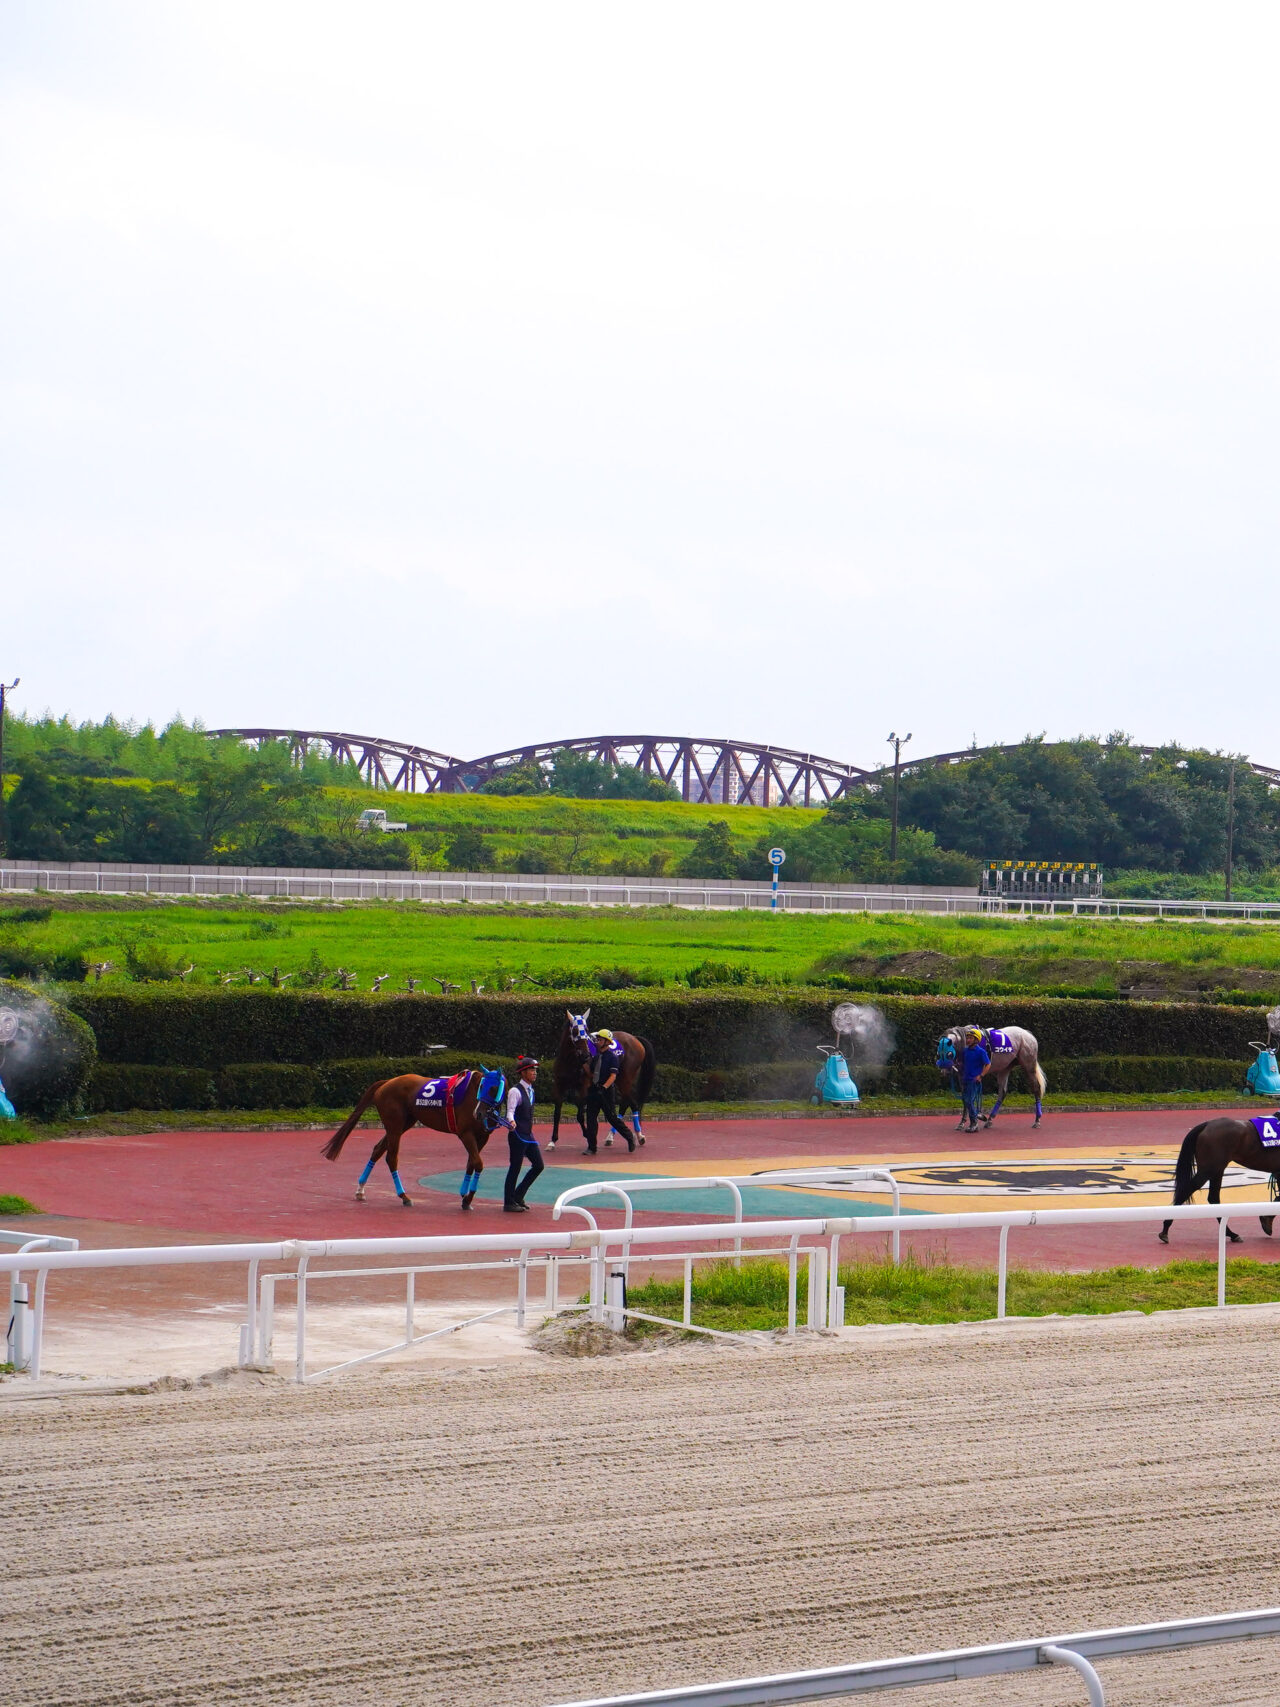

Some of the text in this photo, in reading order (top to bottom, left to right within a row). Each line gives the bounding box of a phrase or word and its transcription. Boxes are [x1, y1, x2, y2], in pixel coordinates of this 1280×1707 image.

[771, 849, 783, 865] 5
[995, 1032, 1005, 1046] 7
[422, 1080, 440, 1098] 5
[1263, 1121, 1278, 1138] 4
